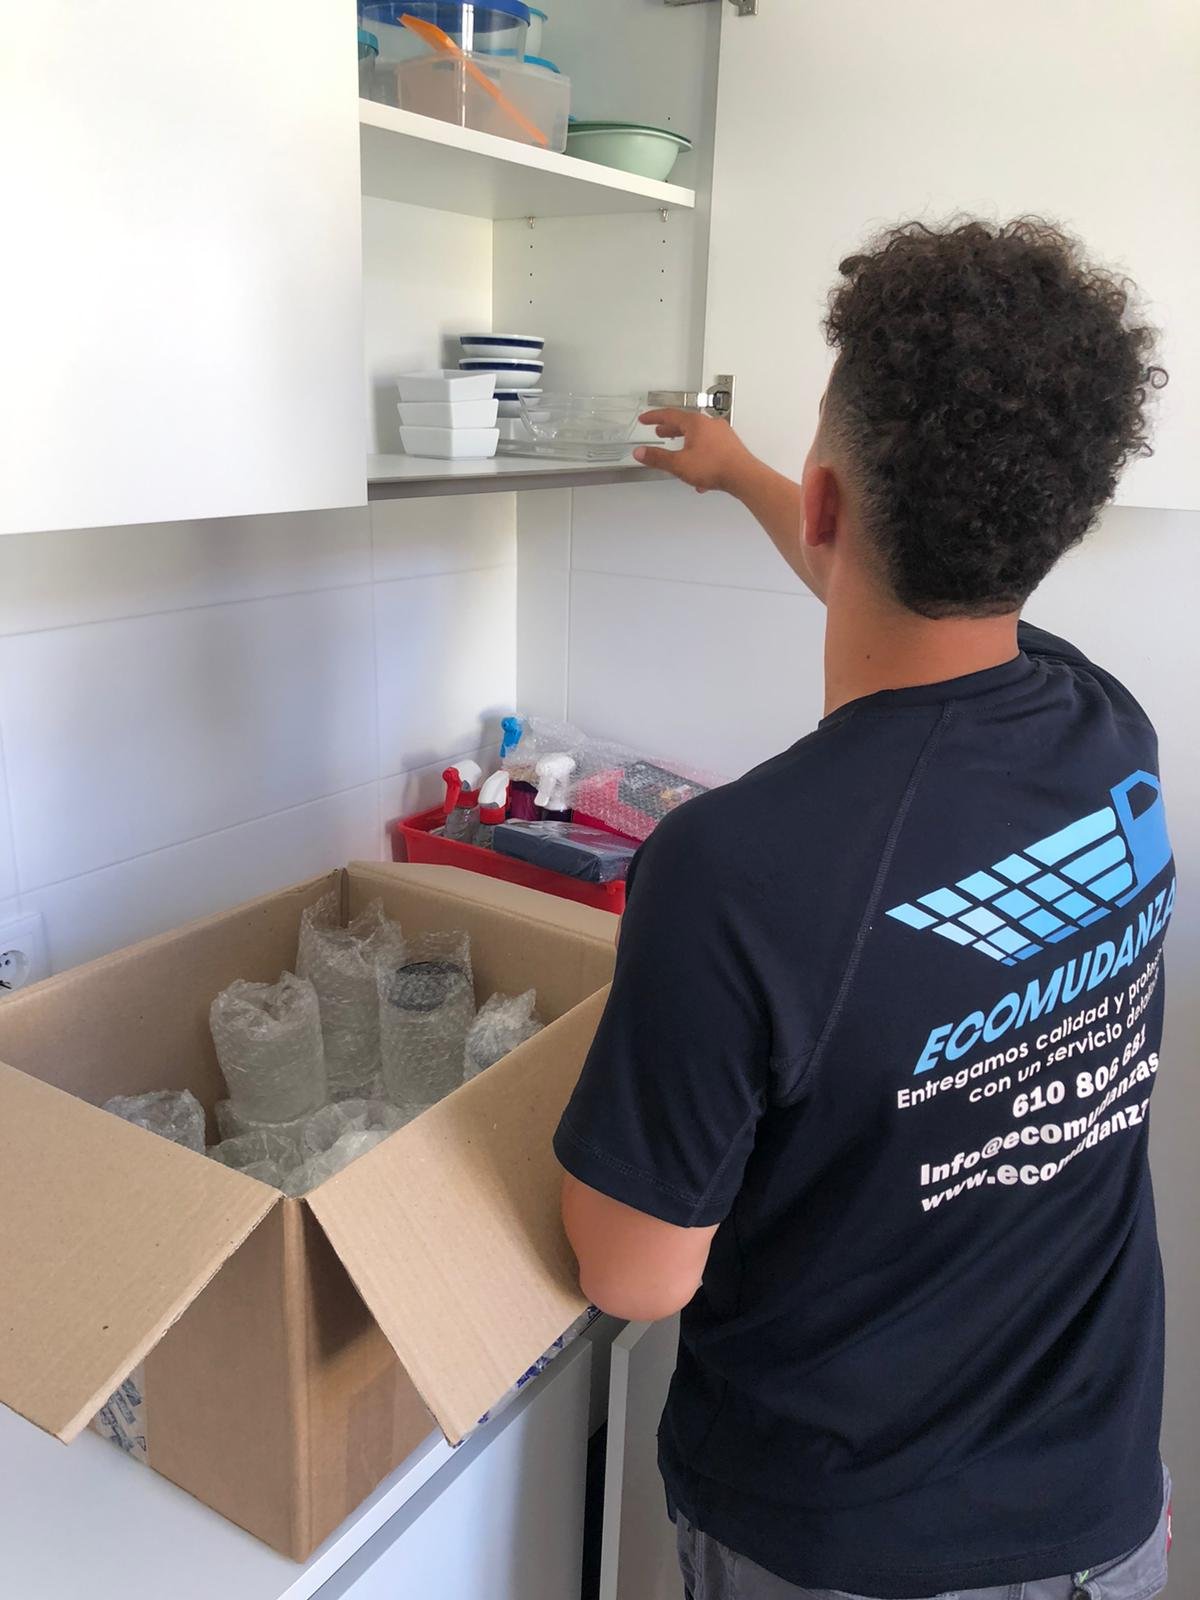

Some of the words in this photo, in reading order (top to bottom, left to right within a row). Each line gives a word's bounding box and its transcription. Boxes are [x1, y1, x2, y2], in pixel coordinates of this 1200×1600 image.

[897, 1042, 1029, 1109] Entregamos
[1036, 996, 1109, 1050] calidad
[1114, 992, 1124, 1014] y
[969, 1076, 1011, 1103] con
[1018, 1062, 1041, 1083] un
[1046, 1022, 1122, 1066] servicio
[1012, 1080, 1066, 1118] 610
[1076, 1057, 1119, 1098] 806
[920, 1052, 1159, 1186] Info@ecomudanzas
